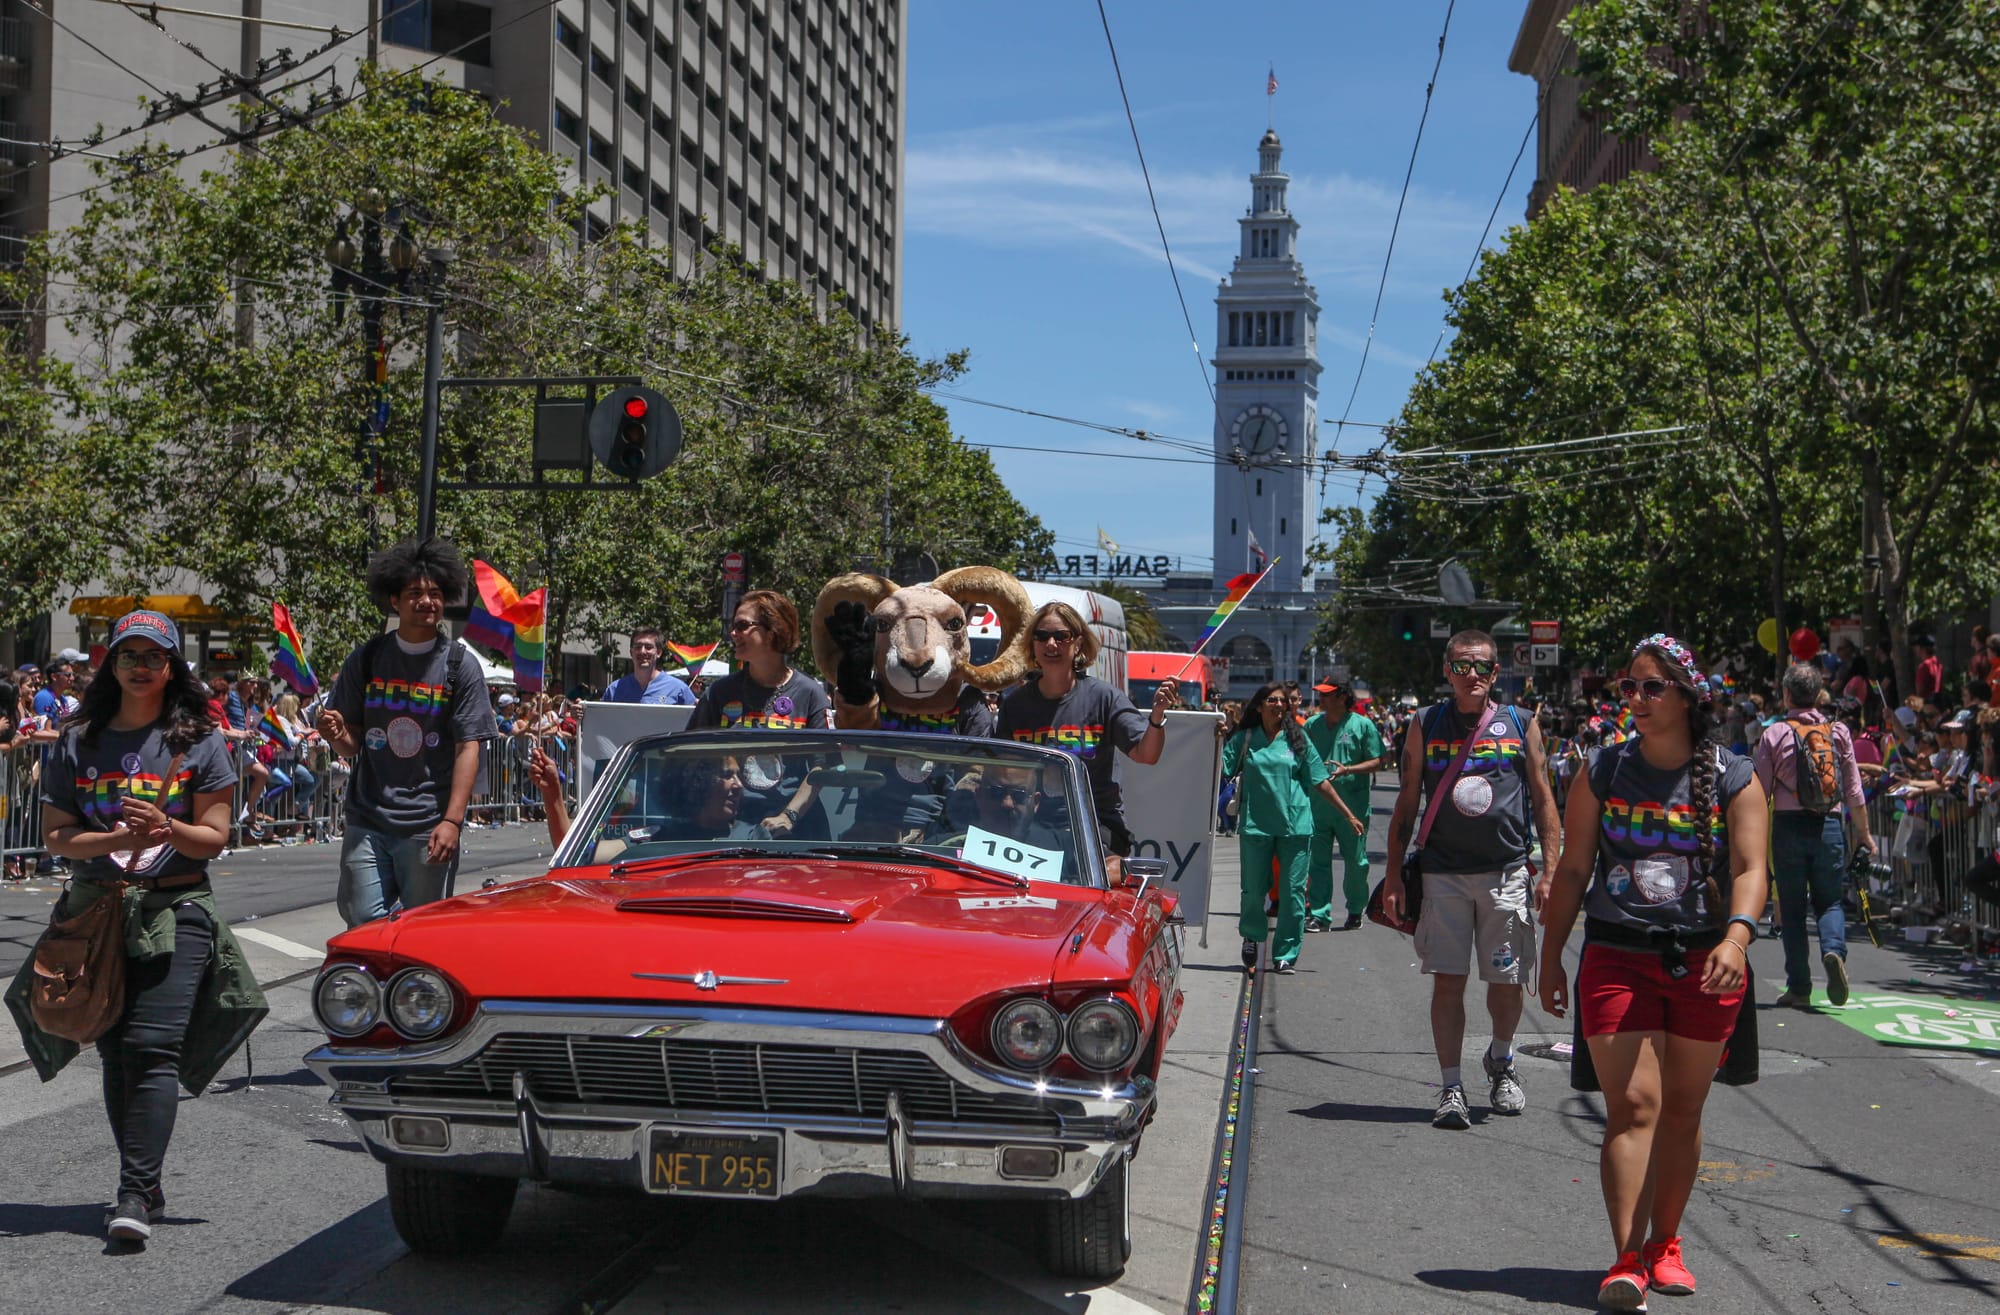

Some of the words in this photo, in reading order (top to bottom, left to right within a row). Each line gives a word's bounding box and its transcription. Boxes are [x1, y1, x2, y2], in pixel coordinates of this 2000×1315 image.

[364, 677, 452, 716] CCSF
[981, 840, 1049, 870] 107
[655, 1152, 713, 1185] NET
[722, 1155, 772, 1188] 955
